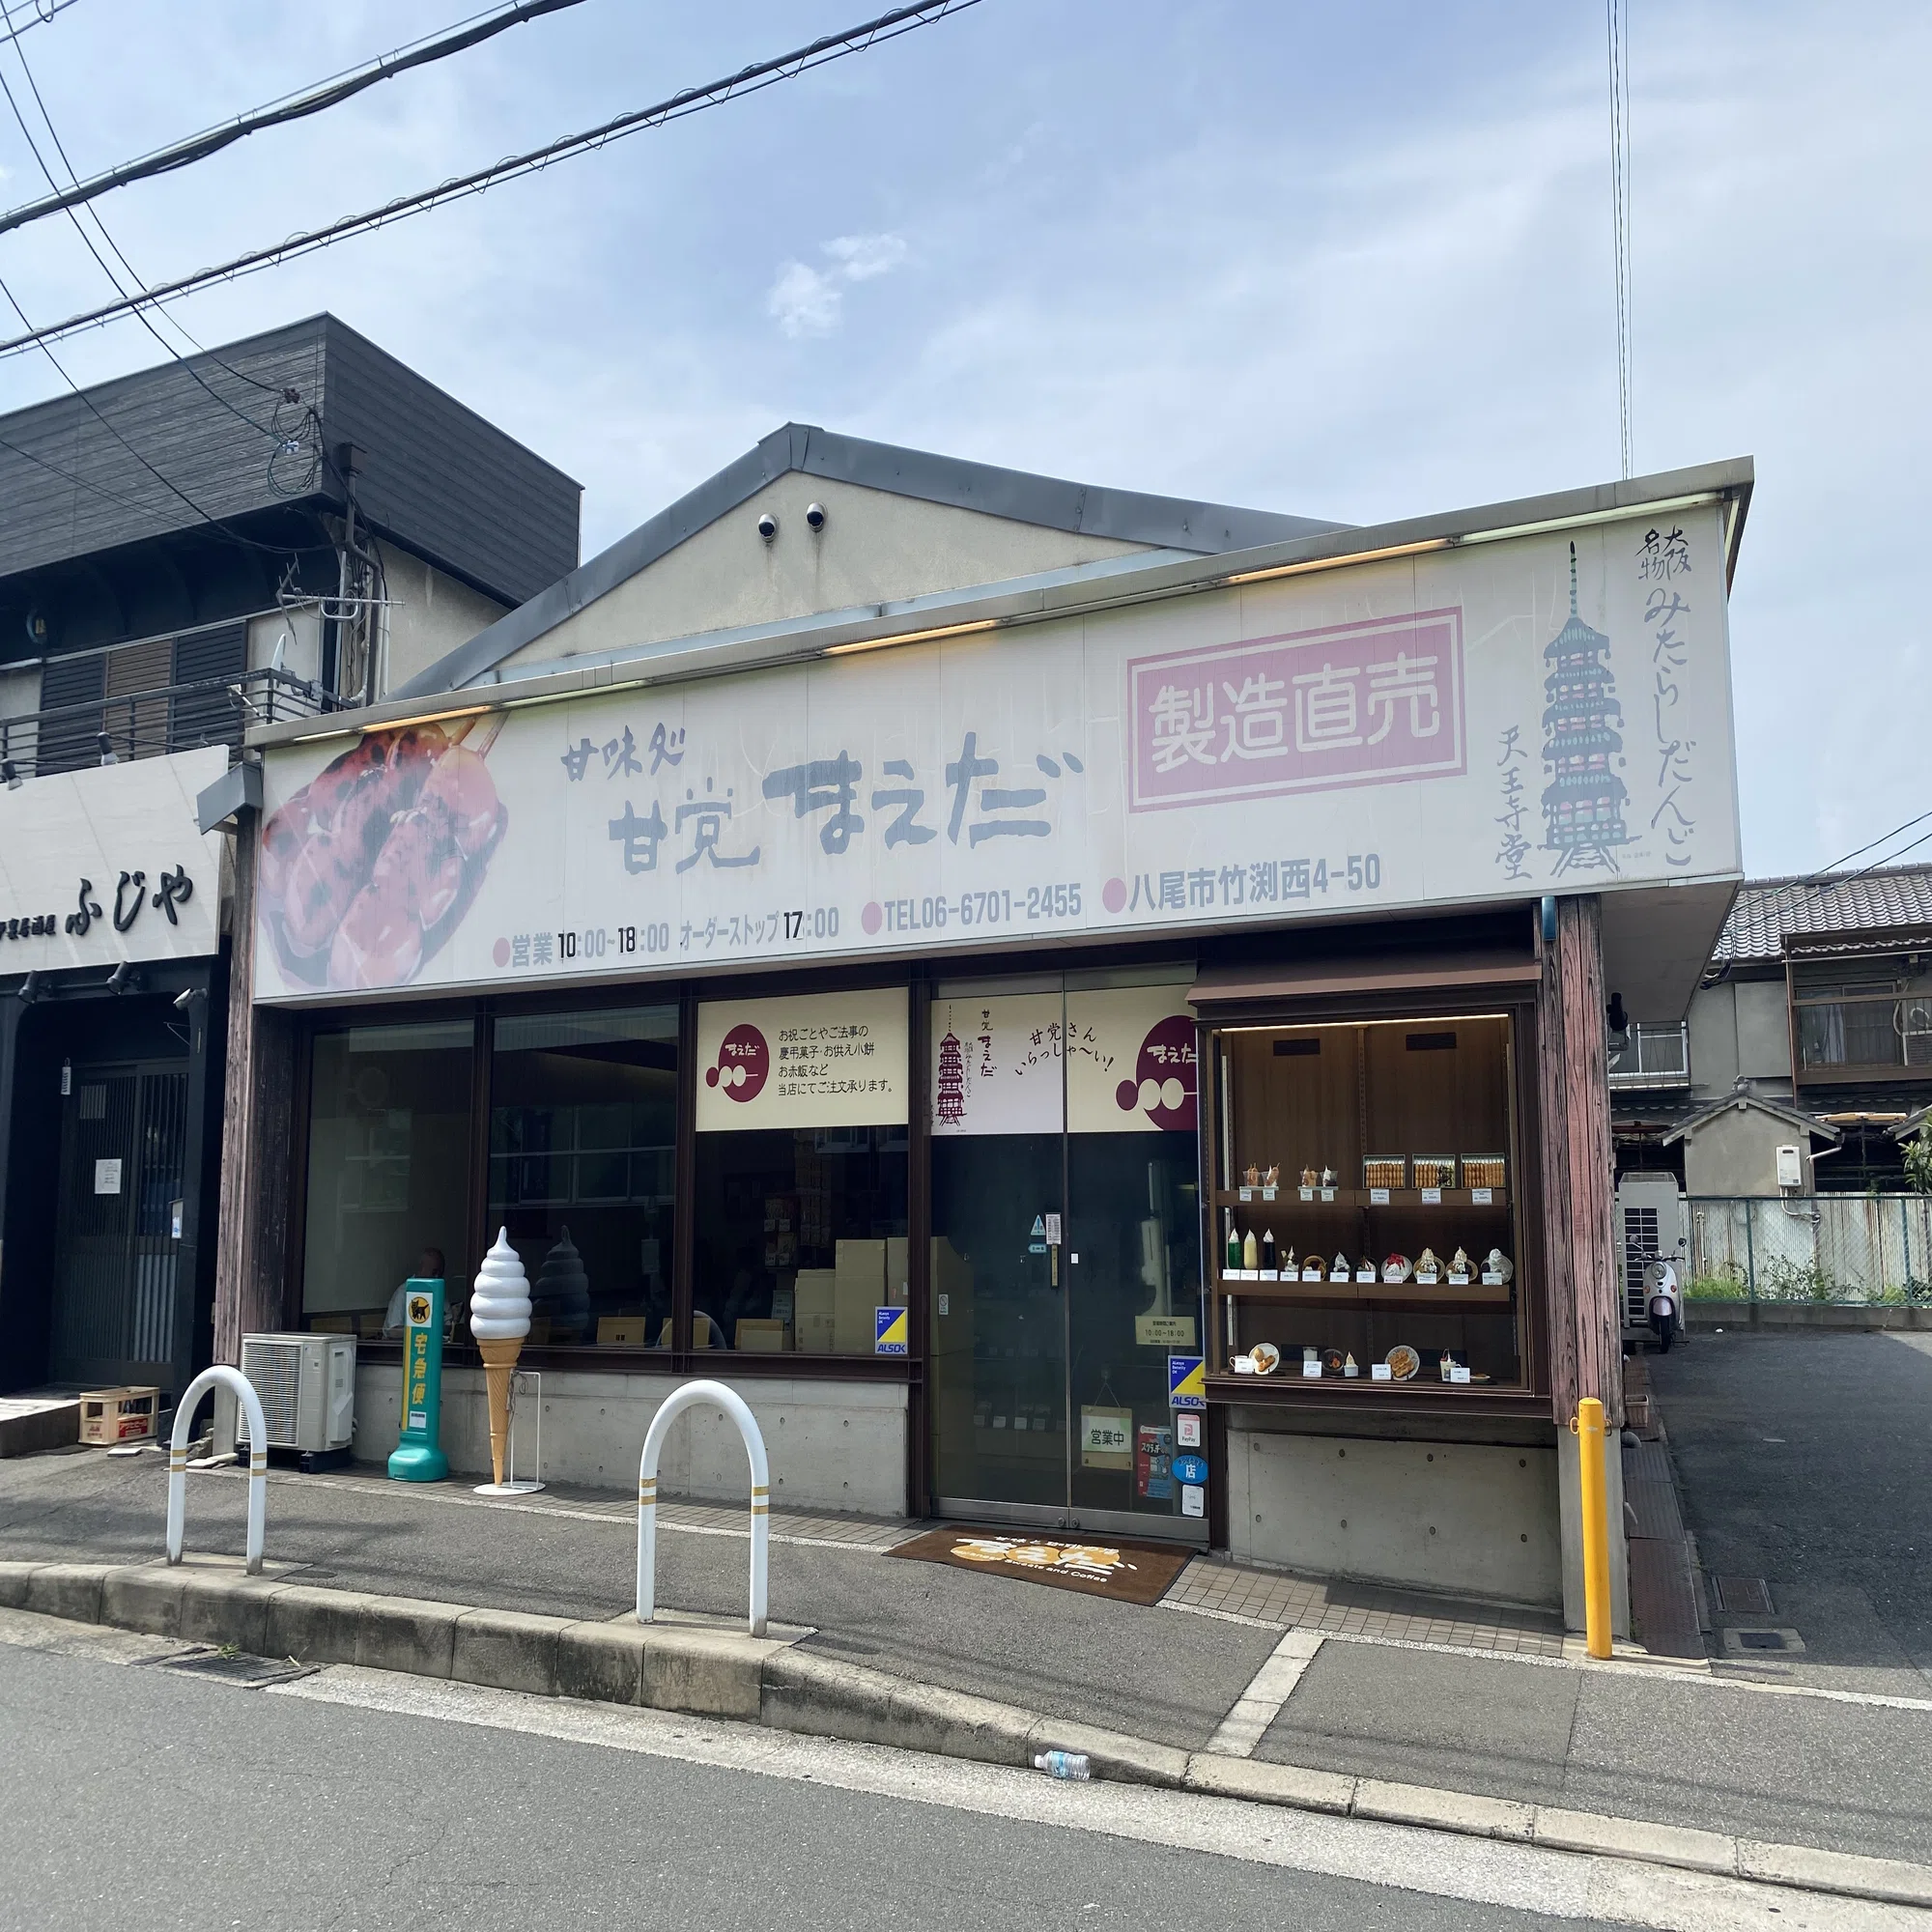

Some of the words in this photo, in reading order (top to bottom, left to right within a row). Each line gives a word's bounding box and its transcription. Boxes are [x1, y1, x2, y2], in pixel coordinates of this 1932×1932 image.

[1149, 652, 1440, 772] 製造直売
[1644, 587, 1697, 866] みたらしだんご
[560, 722, 686, 782] 甘味処
[762, 731, 1085, 856] まえだ
[65, 864, 193, 936] ふじや
[884, 883, 1082, 932] TEL06-6701-2455
[779, 1026, 868, 1042] お祝ごとやご法事の
[1030, 1022, 1097, 1045] 甘党さん
[724, 1043, 760, 1057] まえだ
[978, 1036, 997, 1077] まえだ
[779, 1064, 829, 1077] お赤飯など
[778, 1079, 893, 1096] 当店にてご注文承ります。
[877, 1344, 906, 1353] ALSOK
[412, 1333, 428, 1406] 宅急便
[1091, 1428, 1124, 1446] 営業中
[1185, 1463, 1197, 1479] 店
[955, 1538, 1138, 1576] まえだ
[1005, 1558, 1045, 1571] Sweets
[1046, 1566, 1068, 1575] and
[1070, 1571, 1108, 1583] Coffee
